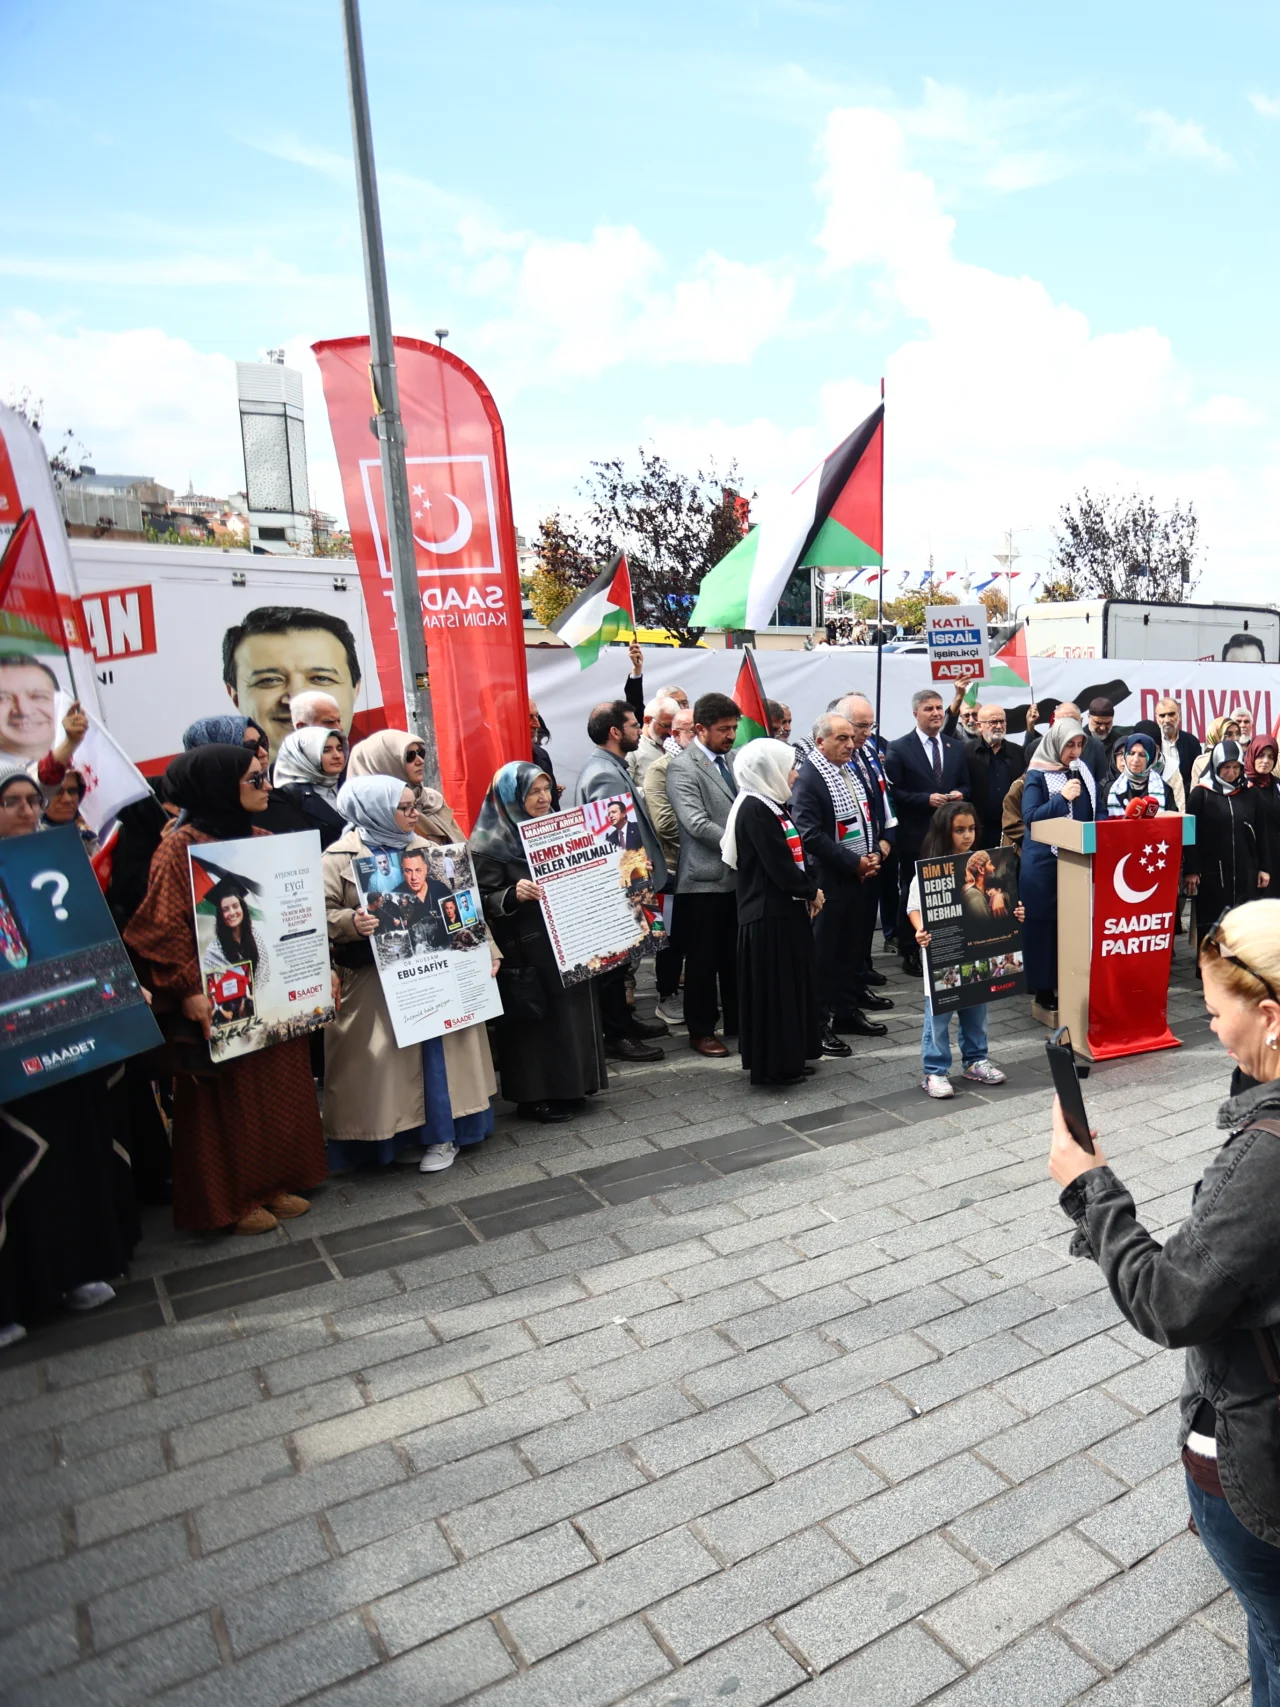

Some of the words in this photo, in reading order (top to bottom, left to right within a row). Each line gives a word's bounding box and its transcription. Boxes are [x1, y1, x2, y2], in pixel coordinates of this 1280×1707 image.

[932, 616, 974, 628] KATİL
[932, 630, 977, 645] İSRAİL
[934, 648, 979, 660] İŞBİRLİKÇİ
[937, 663, 980, 677] ABD!
[525, 823, 558, 838] MAHMUT
[559, 815, 585, 829] ARIKAN
[529, 843, 565, 865] HEMEN
[565, 834, 595, 854] ŞİMDİ!
[533, 860, 565, 878] NELER
[565, 843, 617, 869] YAPILMALI?
[275, 869, 297, 879] AYŞENUR
[922, 863, 941, 879] RİM
[944, 862, 955, 875] VE
[284, 878, 304, 892] EYGİ
[924, 875, 956, 894] DEDESİ
[925, 890, 952, 908] HALİD
[927, 904, 963, 923] NEBHAN
[1103, 911, 1173, 935] SAADET
[1101, 933, 1171, 957] PARTİSİ
[397, 968, 416, 980] EBU
[417, 959, 449, 975] SAFİYE
[297, 984, 323, 998] SAADET
[452, 1012, 475, 1026] SAADET
[41, 1039, 96, 1066] SAADET
